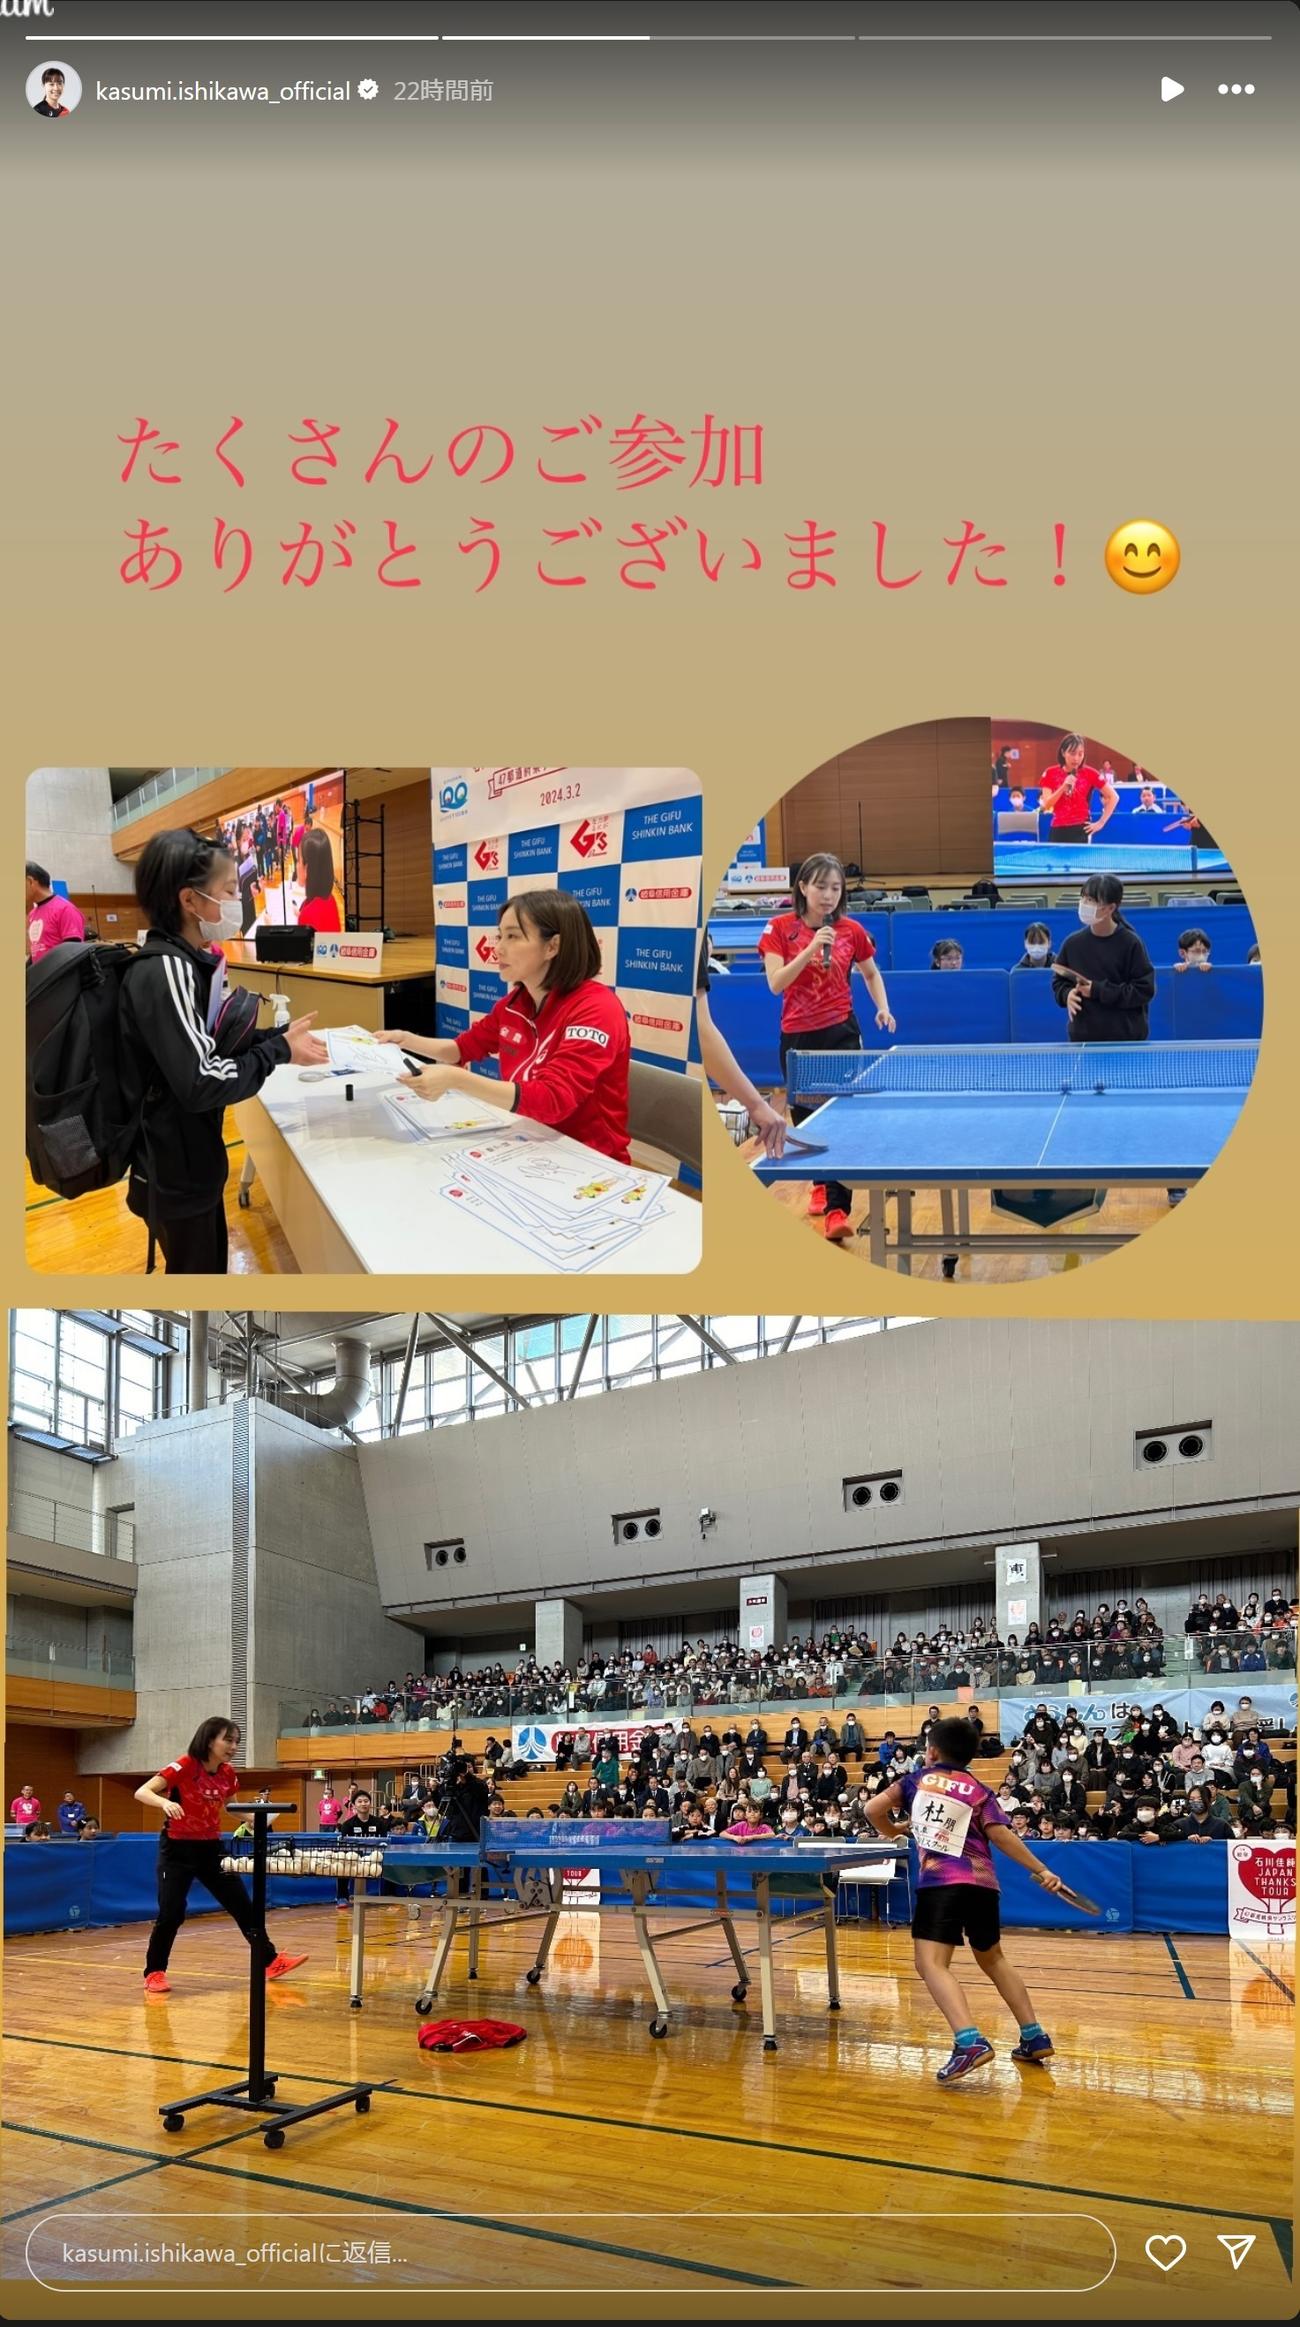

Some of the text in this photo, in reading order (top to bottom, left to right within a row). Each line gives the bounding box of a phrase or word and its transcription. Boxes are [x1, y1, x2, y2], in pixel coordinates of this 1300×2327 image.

[540, 783, 581, 806] 2024.3.2
[644, 810, 681, 824] THE GIFU
[632, 822, 693, 840] SHINKIN BANK
[636, 948, 672, 959] THE GIFU
[625, 959, 683, 973] SHINKIN BANK
[567, 1027, 607, 1045] TOTO
[922, 1773, 975, 1796] GIFU
[1255, 1857, 1296, 1867] 石川佳純
[1258, 1867, 1293, 1877] JAPAN
[1254, 1877, 1296, 1887] THANKS
[1261, 1886, 1290, 1896] TOUR
